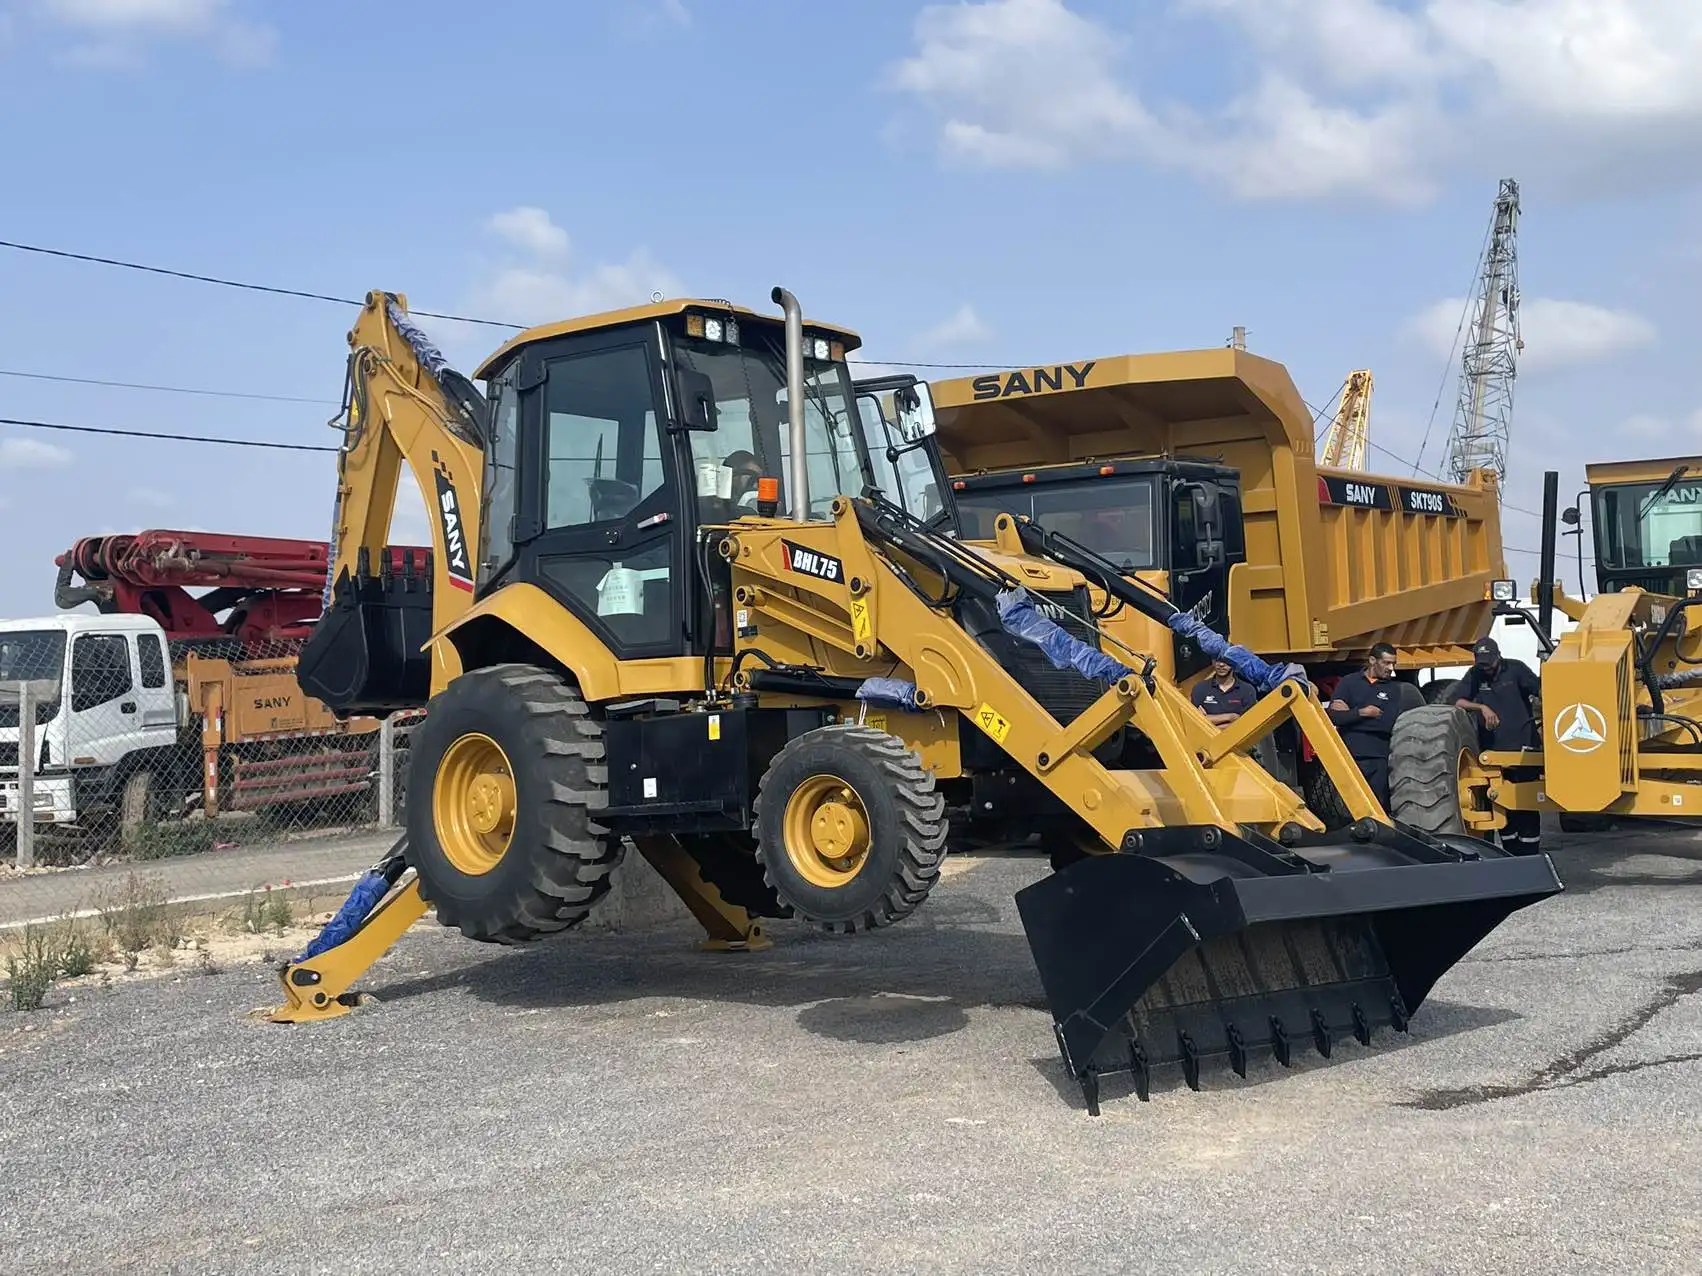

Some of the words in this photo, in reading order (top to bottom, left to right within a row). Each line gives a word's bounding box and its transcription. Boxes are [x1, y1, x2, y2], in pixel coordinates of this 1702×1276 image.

[972, 361, 1096, 400] SANY
[1346, 483, 1376, 505] SANY
[1410, 491, 1443, 512] SKT90S
[441, 490, 465, 569] SANY
[793, 549, 838, 579] BHL75
[1034, 603, 1066, 620] ANY
[253, 696, 291, 709] SANY
